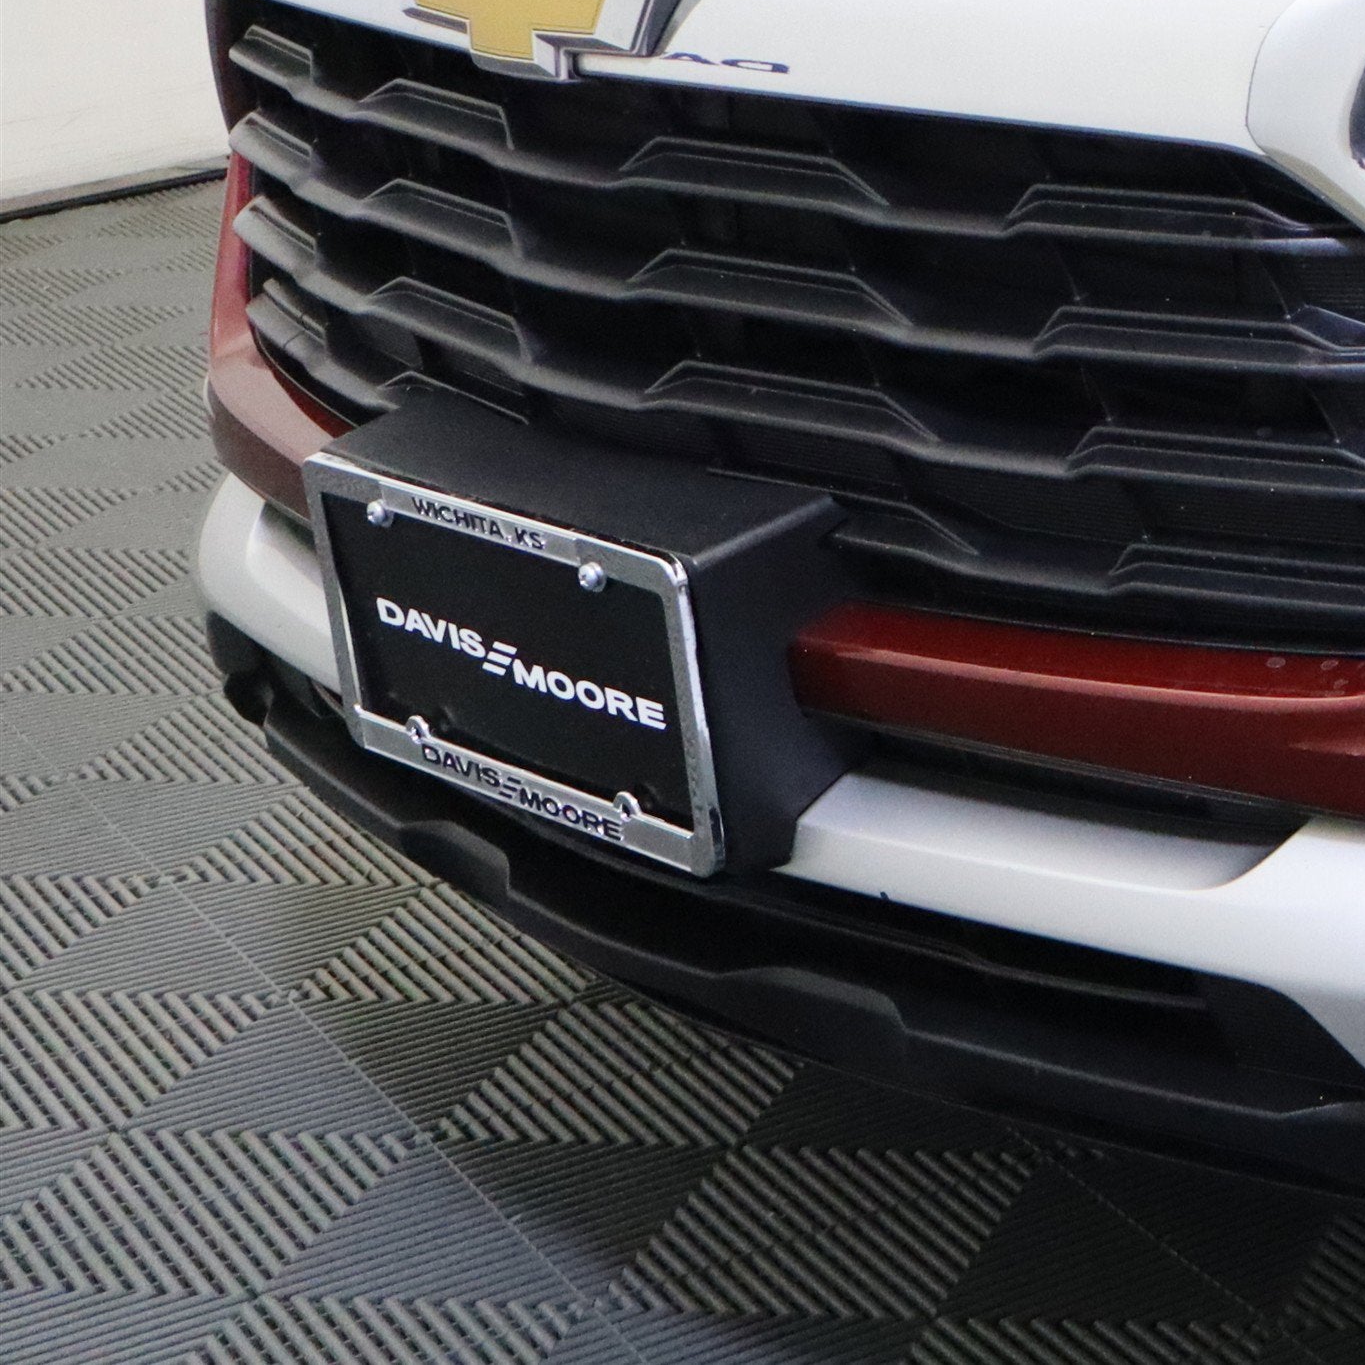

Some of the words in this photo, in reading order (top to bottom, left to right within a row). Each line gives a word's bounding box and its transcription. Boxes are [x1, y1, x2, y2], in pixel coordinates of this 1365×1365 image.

[514, 526, 546, 550] KS
[376, 597, 486, 658] DAVIS
[512, 658, 667, 730] MOORE
[421, 744, 500, 787] DAVIS
[519, 787, 622, 841] MOORE
